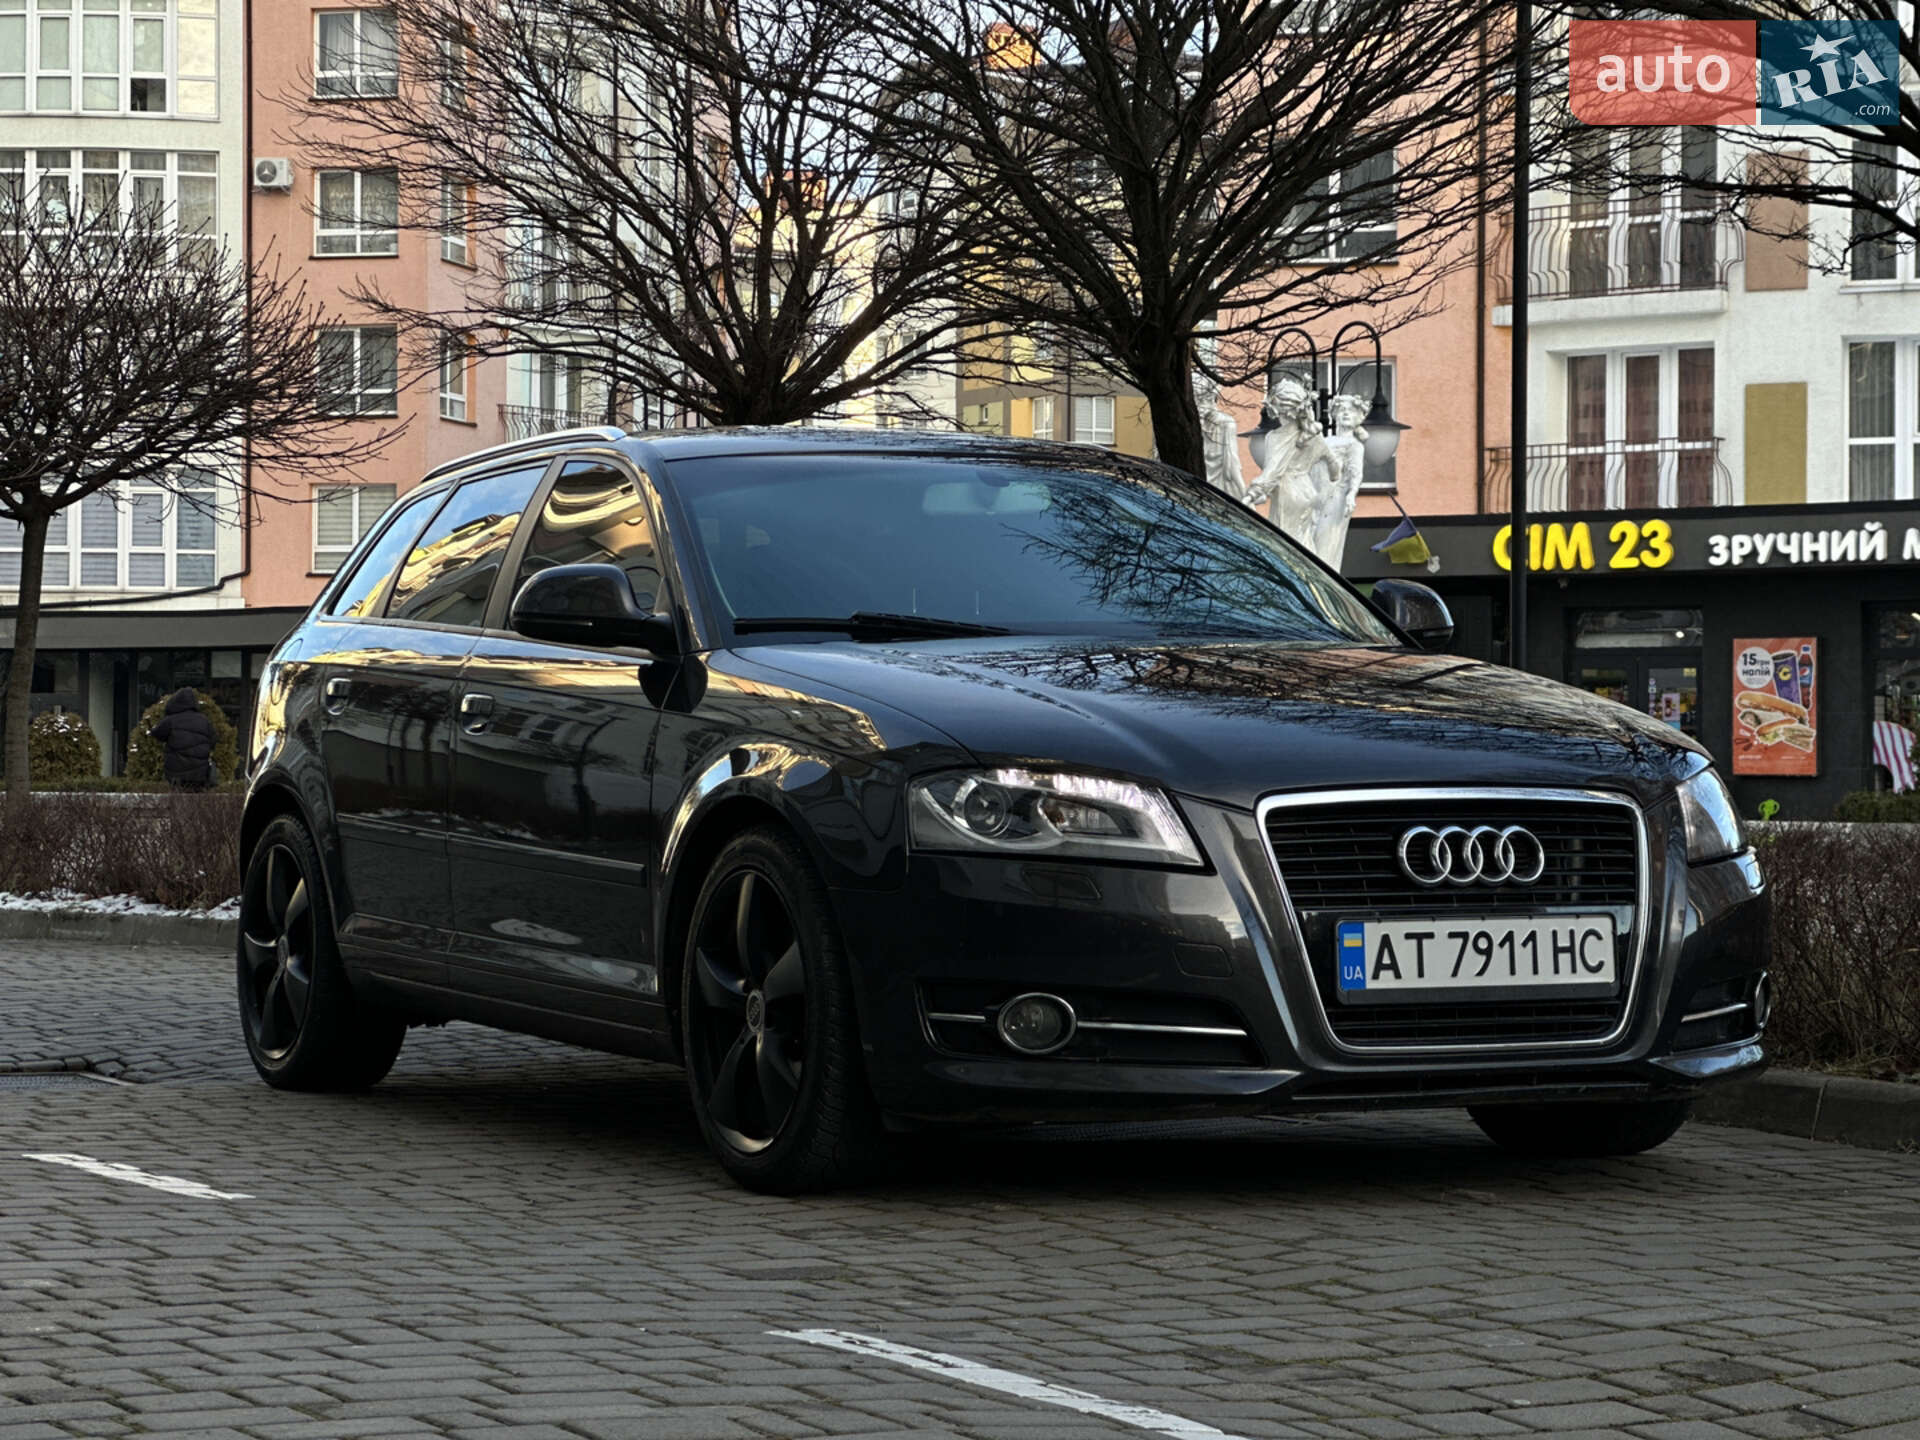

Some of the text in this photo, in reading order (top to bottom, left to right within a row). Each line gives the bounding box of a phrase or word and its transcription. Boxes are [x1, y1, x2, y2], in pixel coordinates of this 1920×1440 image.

[1609, 519, 1674, 568] 23
[1708, 521, 1887, 566] ЗРУЧНИЙ
[1344, 965, 1364, 981] UA
[1371, 928, 1605, 980] AT 7911 HC
